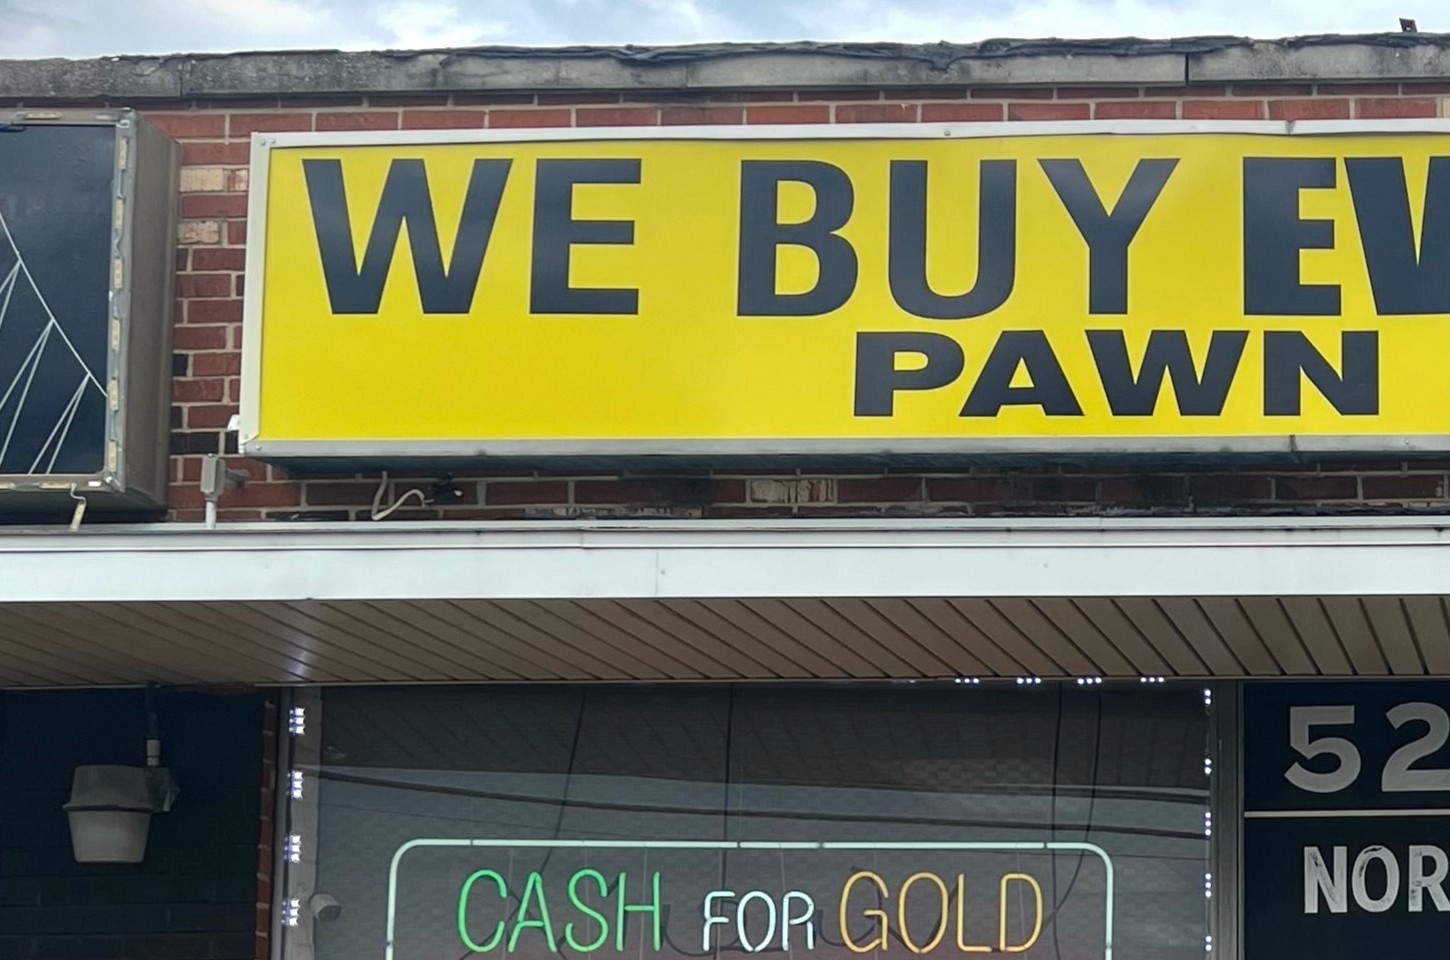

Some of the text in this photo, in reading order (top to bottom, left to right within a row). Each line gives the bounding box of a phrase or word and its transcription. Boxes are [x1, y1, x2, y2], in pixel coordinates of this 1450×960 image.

[302, 157, 642, 317] WE
[737, 156, 1180, 320] BUY
[854, 329, 1380, 418] PAWN
[458, 868, 1045, 954] CASH FOR GOLD
